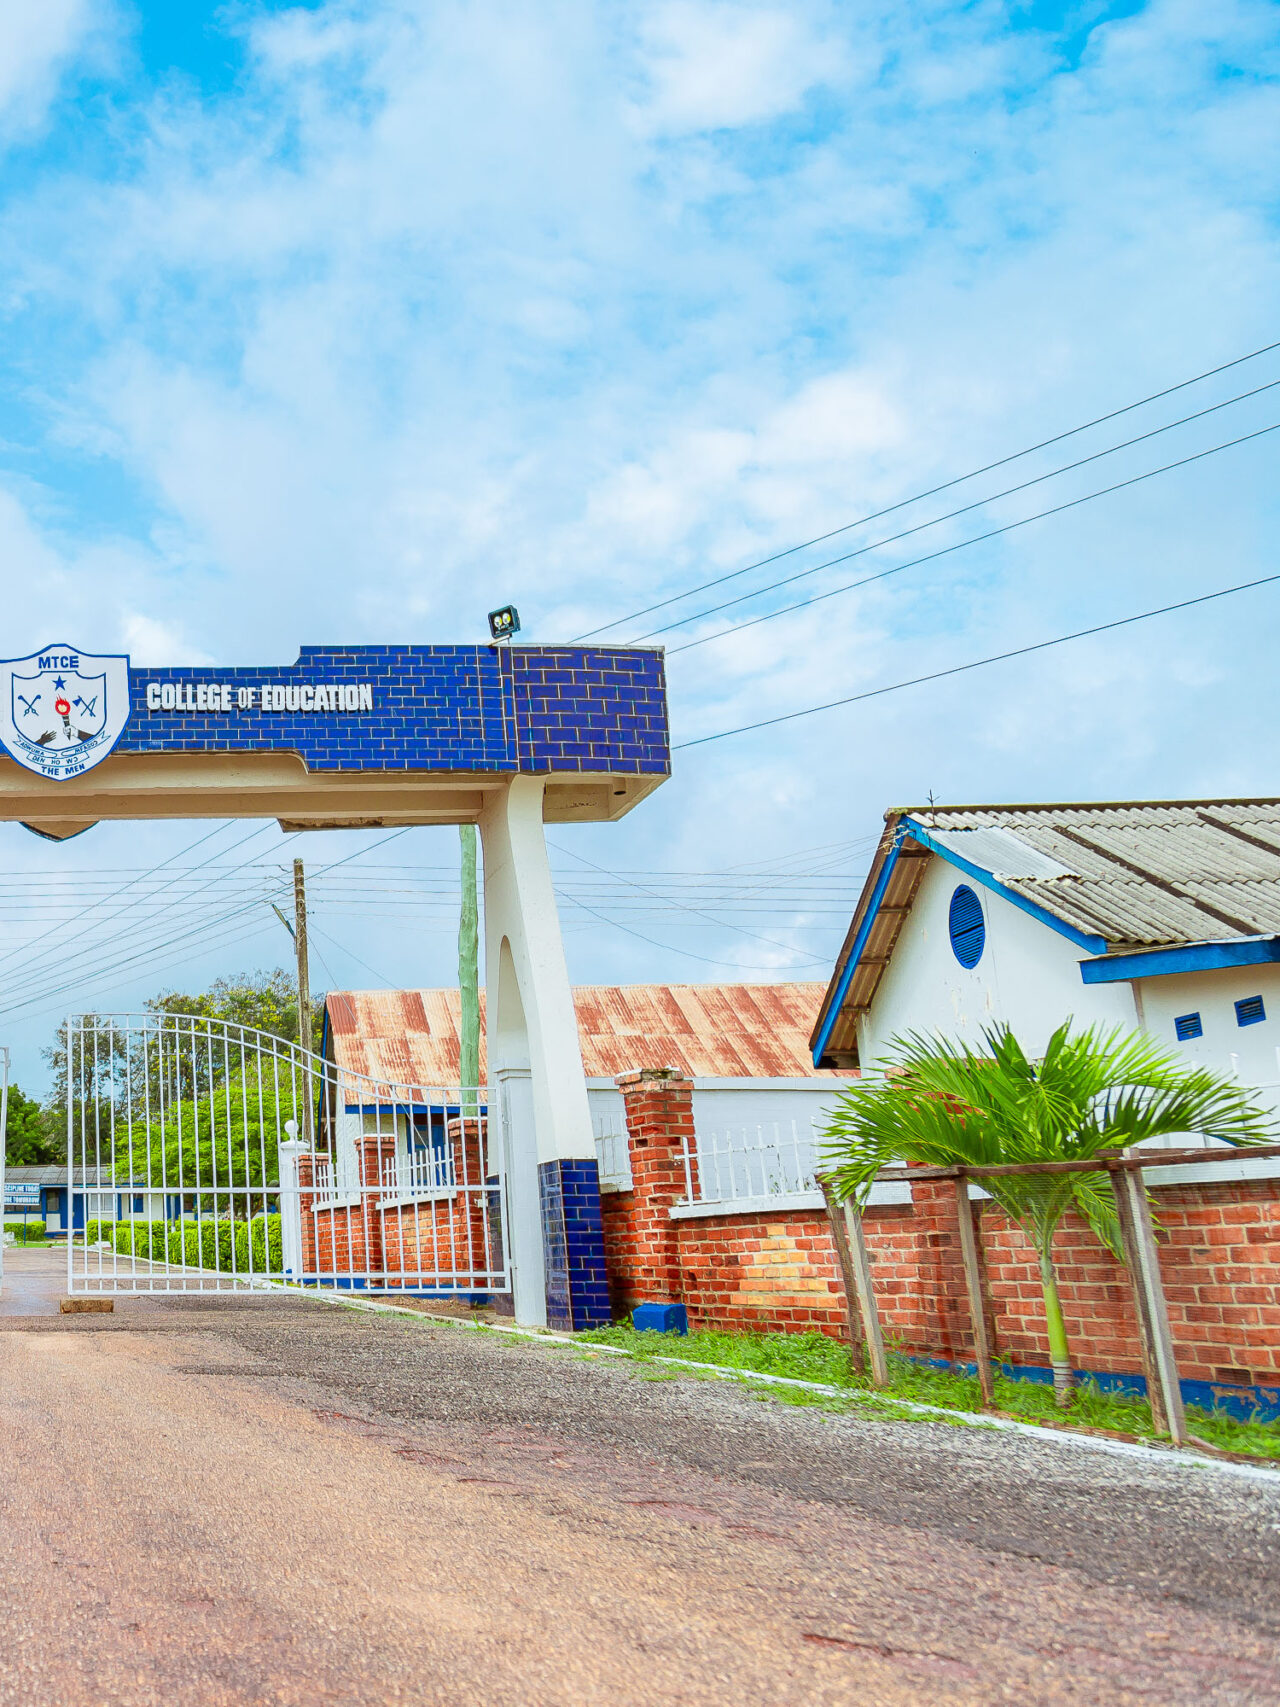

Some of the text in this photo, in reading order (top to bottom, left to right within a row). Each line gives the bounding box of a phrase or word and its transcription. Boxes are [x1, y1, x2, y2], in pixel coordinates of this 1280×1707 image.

[38, 655, 79, 669] MTCE
[146, 683, 374, 711] COLLEGE OF EDUCATION
[32, 755, 45, 763] DEN
[41, 763, 85, 776] THE MEN
